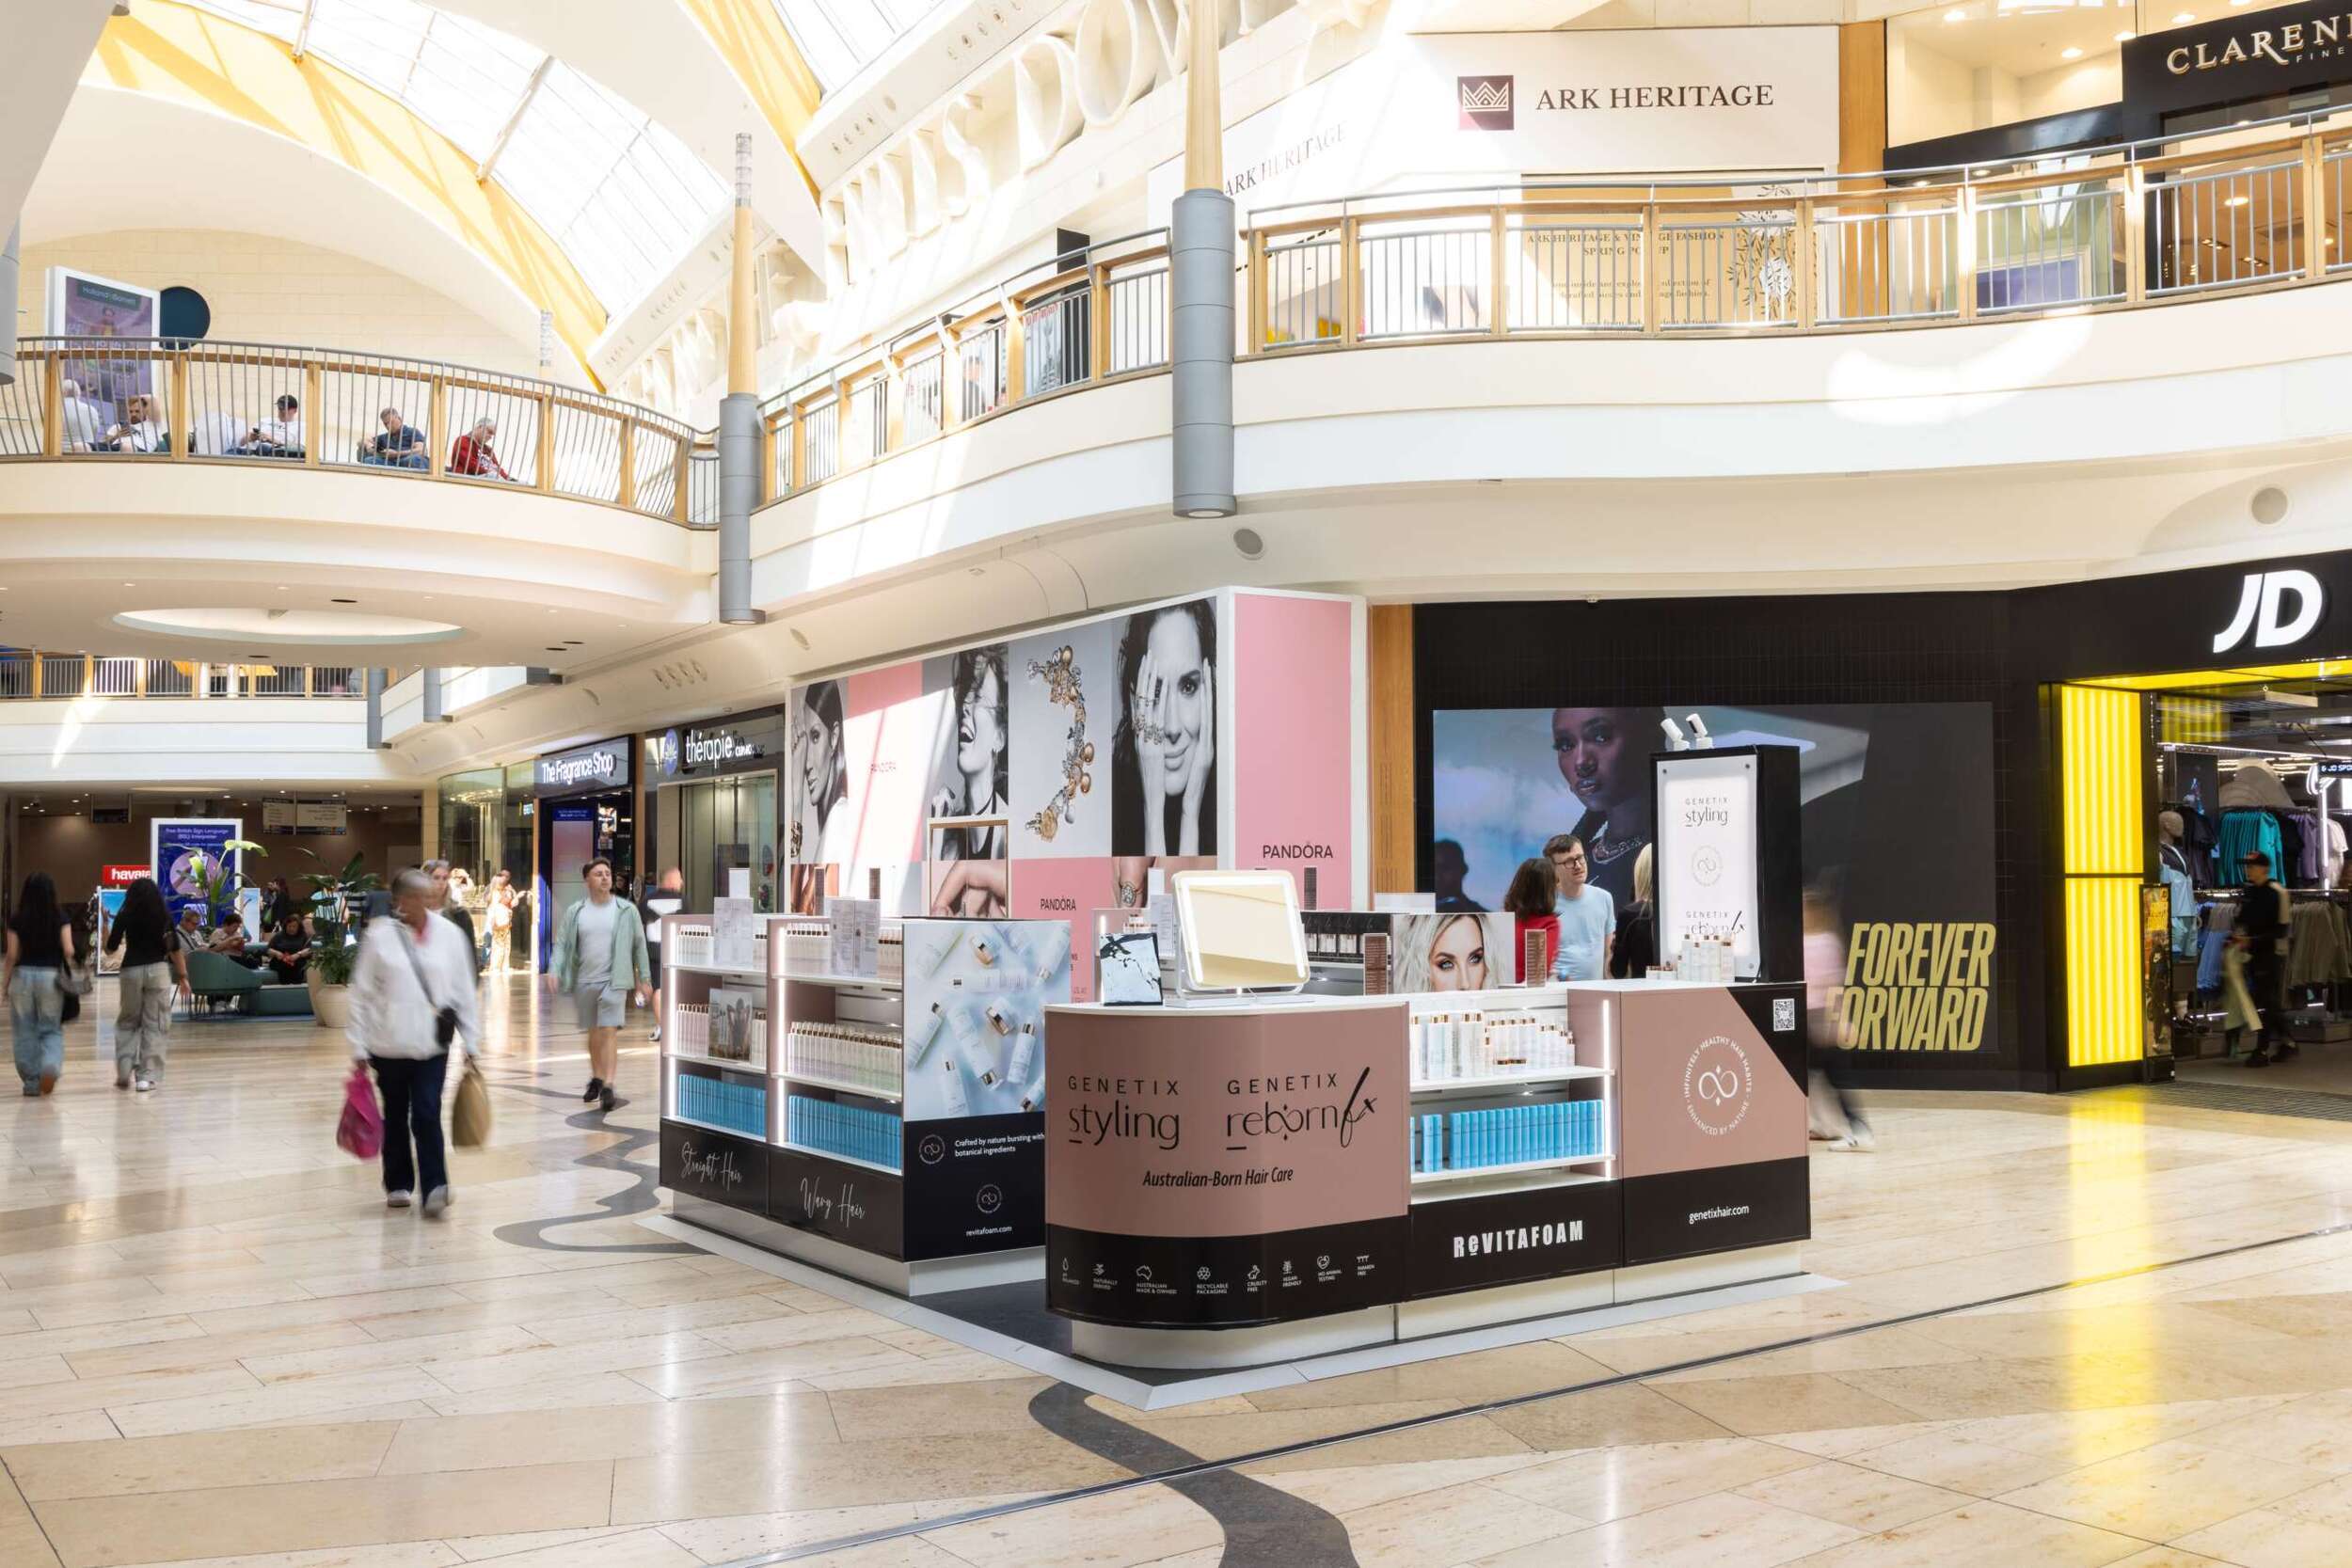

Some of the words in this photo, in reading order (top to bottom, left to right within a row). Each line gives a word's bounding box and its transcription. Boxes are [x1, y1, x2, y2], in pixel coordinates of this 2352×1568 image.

[2296, 46, 2345, 63] FINE
[1536, 88, 1601, 110] ARK
[1610, 85, 1774, 108] HERITAGE
[1225, 167, 1256, 197] ARK
[2213, 570, 2323, 654] JD
[686, 730, 733, 768] thérapie
[542, 762, 555, 784] The
[556, 760, 593, 785] Fragrance
[593, 752, 613, 777] Shop
[1685, 806, 1728, 827] styling
[1844, 923, 1996, 987] FOREVER
[1824, 987, 1989, 1051] FORWARD
[1068, 1075, 1179, 1096] GENETIX
[1227, 1072, 1338, 1094] GENETIX
[1069, 1100, 1180, 1150] styling
[954, 1137, 978, 1147] Crafted
[978, 1137, 987, 1146] by
[987, 1135, 1006, 1144] nature
[1007, 1134, 1031, 1144] bursting
[954, 1148, 982, 1157] botanical
[983, 1146, 1016, 1156] ingredients
[681, 1142, 720, 1183] Straight
[721, 1151, 741, 1192] Hair
[1142, 1170, 1242, 1187] Australian-Born
[1245, 1168, 1269, 1185] Hair
[1271, 1166, 1294, 1182] Care
[801, 1177, 833, 1219] Wavy
[837, 1183, 866, 1227] Hair
[1689, 1205, 1750, 1225] genetixhair.com
[965, 1226, 1012, 1236] revitafoam.com
